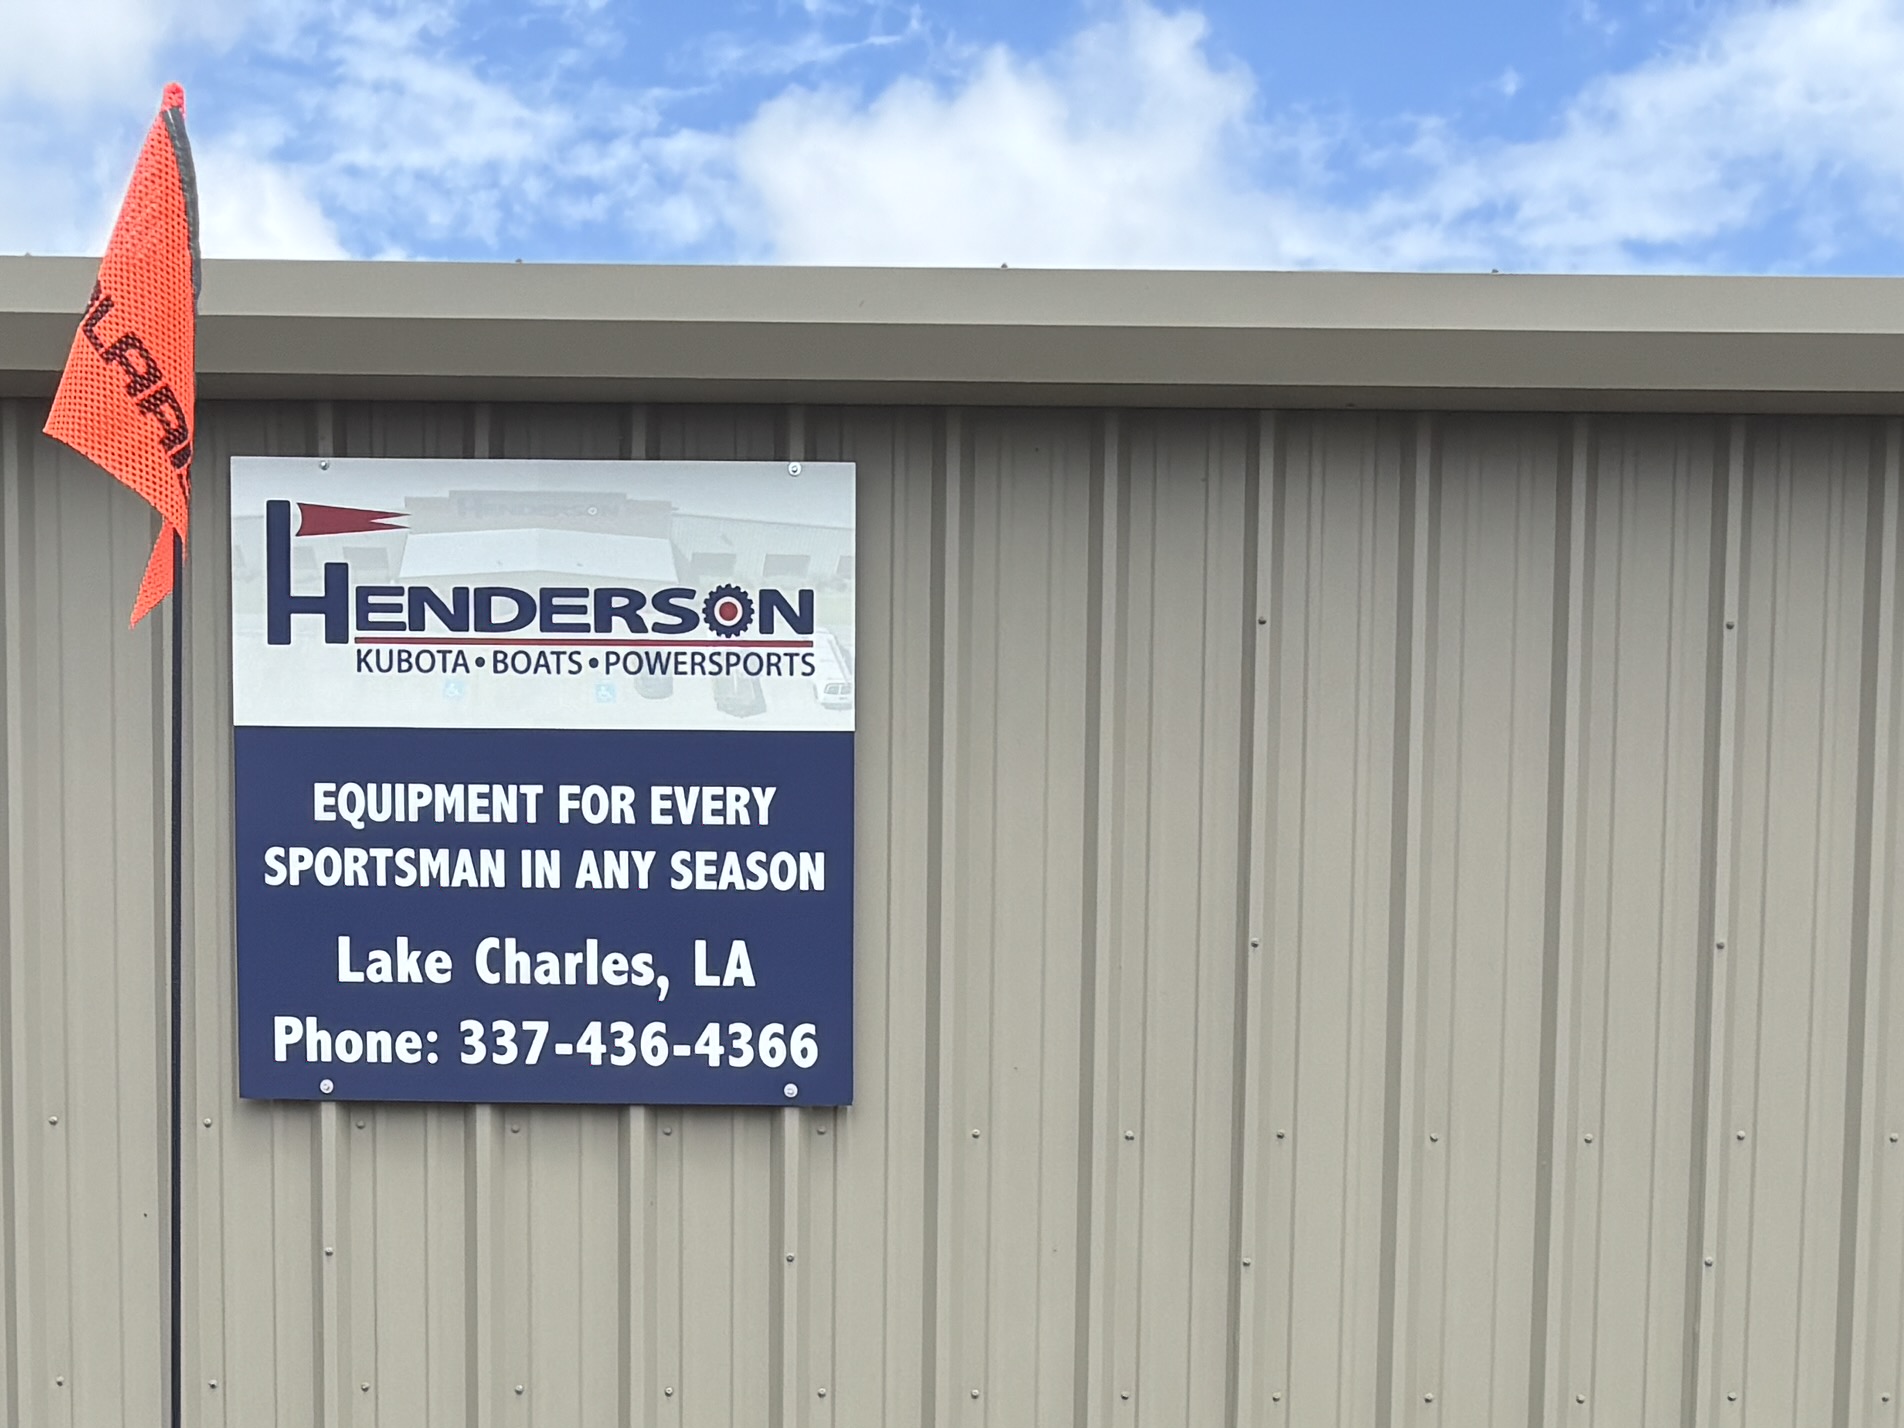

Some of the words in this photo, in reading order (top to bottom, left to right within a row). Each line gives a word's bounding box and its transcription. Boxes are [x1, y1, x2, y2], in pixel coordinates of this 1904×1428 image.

[266, 500, 815, 645] HENDERSON
[356, 649, 470, 675] KUBOTA
[492, 650, 583, 676] BOATS
[605, 651, 815, 677] POWERSPORTS
[314, 782, 544, 830] EQUIPMENT
[559, 784, 636, 825] FOR
[650, 786, 777, 826] EVERY
[264, 846, 506, 888] SPORTSMAN
[521, 849, 561, 889] IN
[575, 849, 657, 890] ANY
[670, 850, 825, 891] SEASON
[338, 935, 453, 984] Lake
[475, 936, 670, 1002] Charles,
[694, 939, 756, 987] LA
[274, 1015, 439, 1064] Phone:
[460, 1019, 818, 1069] 337-436-4366
